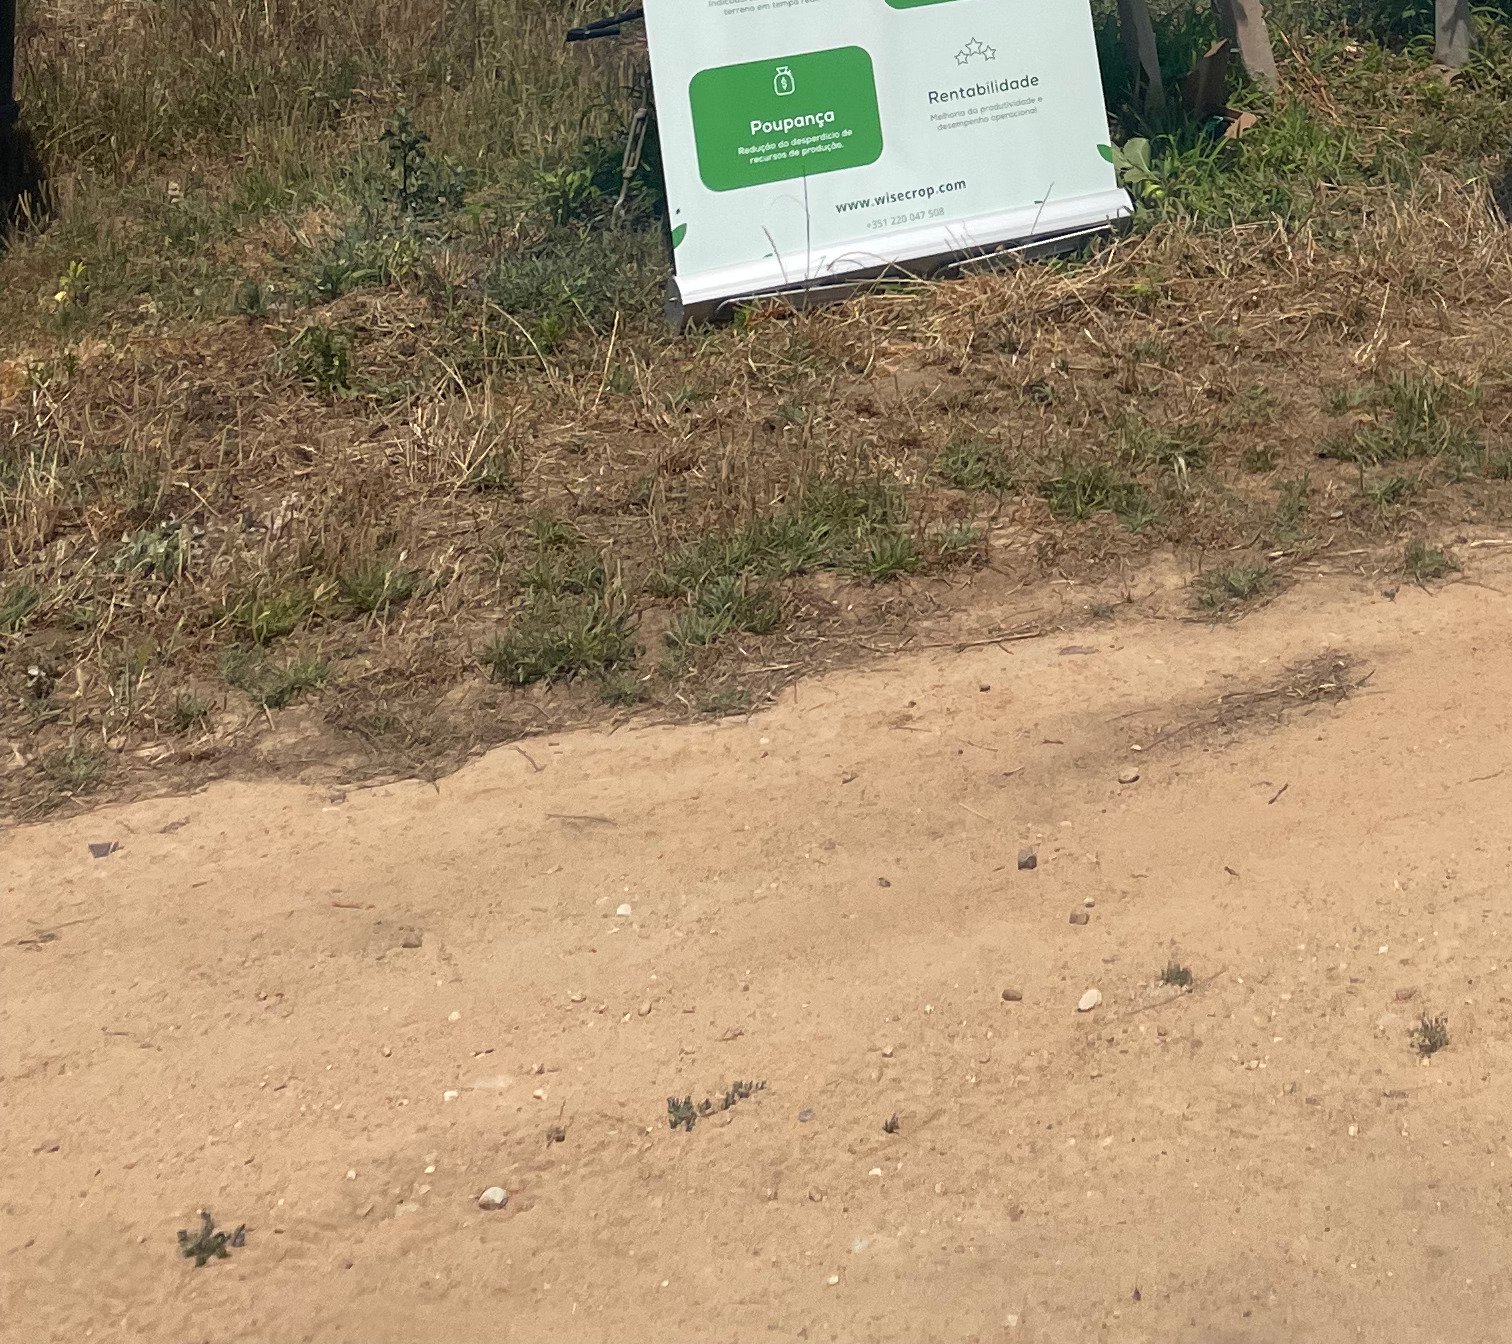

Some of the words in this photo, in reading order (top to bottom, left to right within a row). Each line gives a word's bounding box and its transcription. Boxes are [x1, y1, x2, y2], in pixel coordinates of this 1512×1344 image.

[724, 6, 755, 16] terreno
[928, 75, 1040, 104] Rentabilidade
[750, 111, 835, 135] Poupança
[835, 180, 967, 213] www.wisecrop.com
[891, 215, 908, 226] 220
[909, 211, 926, 222] 047
